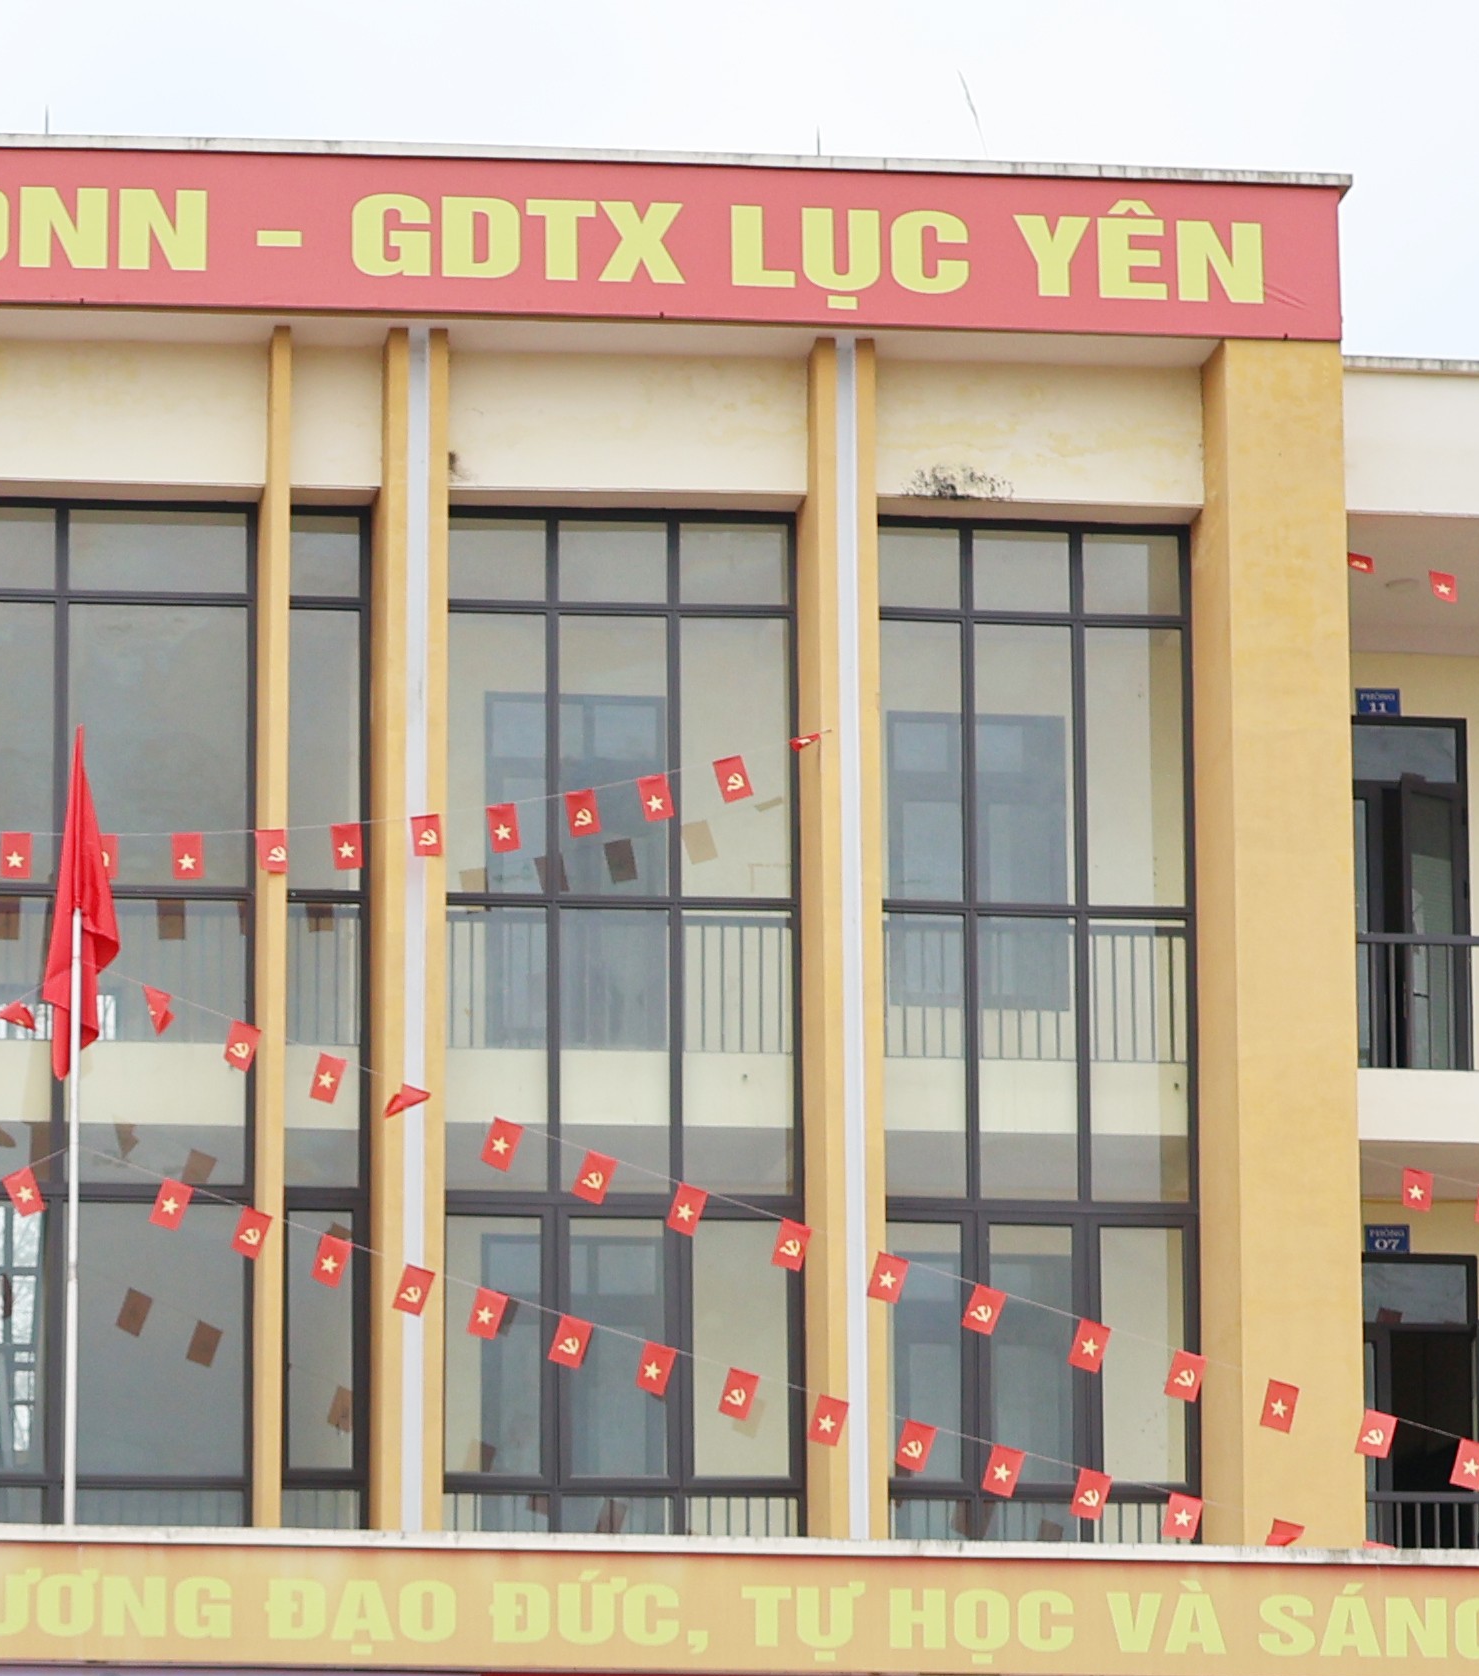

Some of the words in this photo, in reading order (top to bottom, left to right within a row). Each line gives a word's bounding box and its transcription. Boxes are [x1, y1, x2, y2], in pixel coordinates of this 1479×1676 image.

[259, 231, 302, 245] -
[354, 195, 681, 282] GDTX
[733, 206, 968, 308] LỤC
[1019, 201, 1263, 301] YÊN
[1360, 691, 1395, 700] PHÒNG
[1370, 702, 1387, 713] 11
[1369, 1226, 1405, 1238] PHÒNG
[1375, 1238, 1401, 1250] 07
[266, 1570, 457, 1658] ĐẠO
[490, 1570, 712, 1658] ĐỨC,
[740, 1577, 868, 1667] TỰ
[883, 1586, 1078, 1667] HỌC
[1105, 1577, 1230, 1657] VÀ
